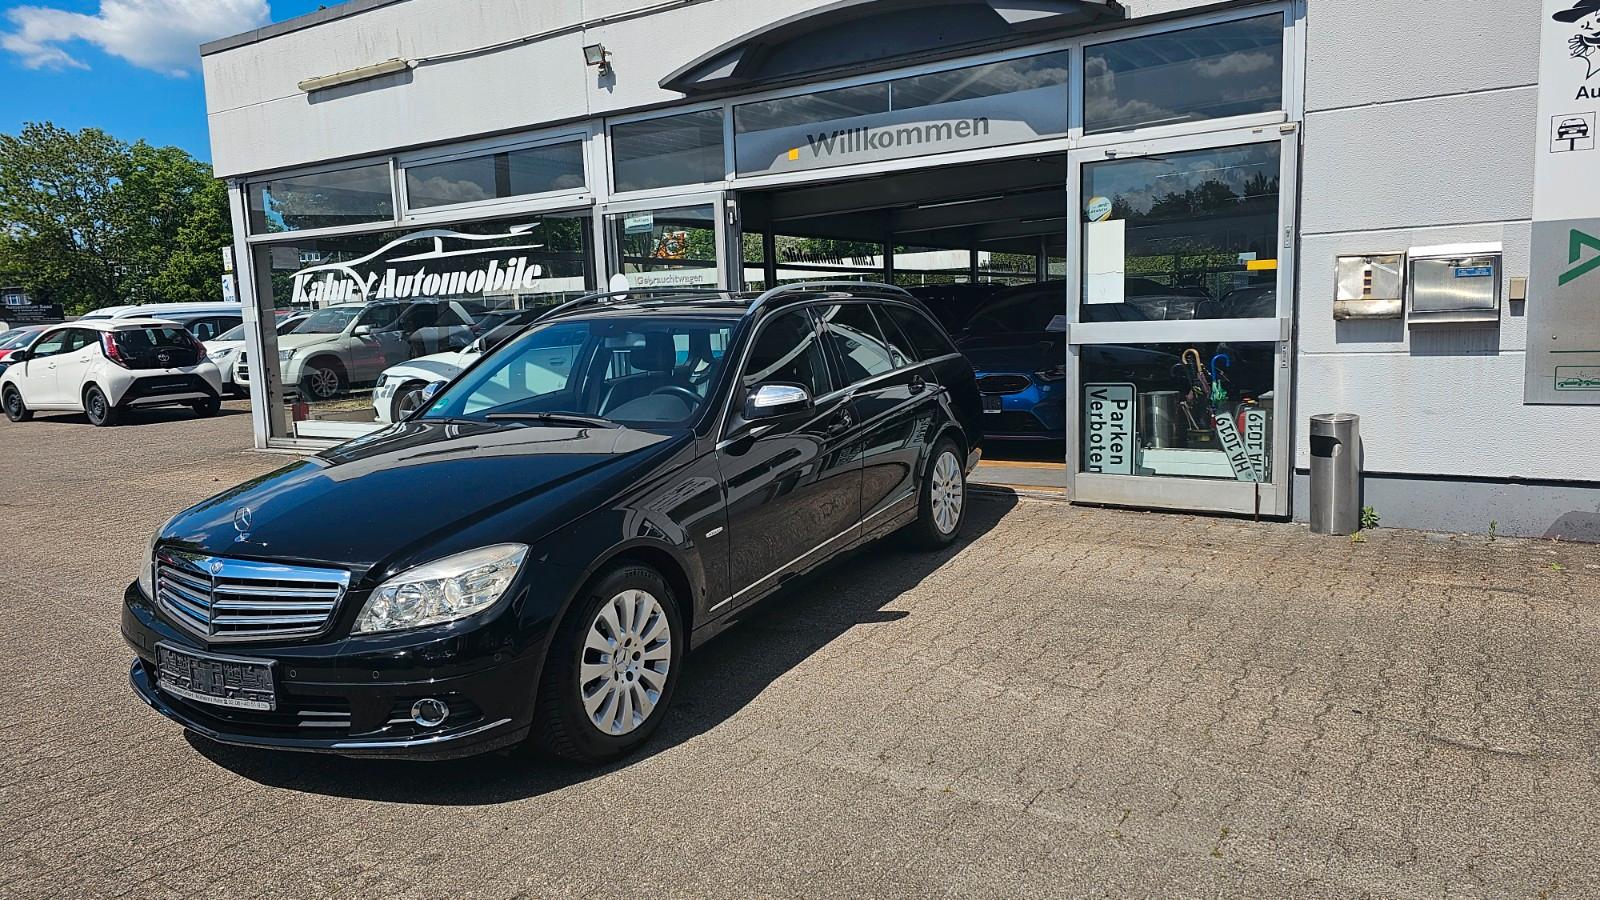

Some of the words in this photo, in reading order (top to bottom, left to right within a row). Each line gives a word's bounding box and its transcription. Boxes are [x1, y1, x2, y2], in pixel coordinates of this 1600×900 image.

[807, 117, 989, 158] Willkommen
[375, 257, 542, 299] Automobile
[637, 274, 704, 286] Gebrauchtwagen
[1090, 388, 1107, 473] Verboten
[1110, 399, 1128, 465] Parken
[1216, 417, 1242, 451] 1019
[1247, 413, 1263, 450] 1019
[1232, 452, 1251, 473] HA
